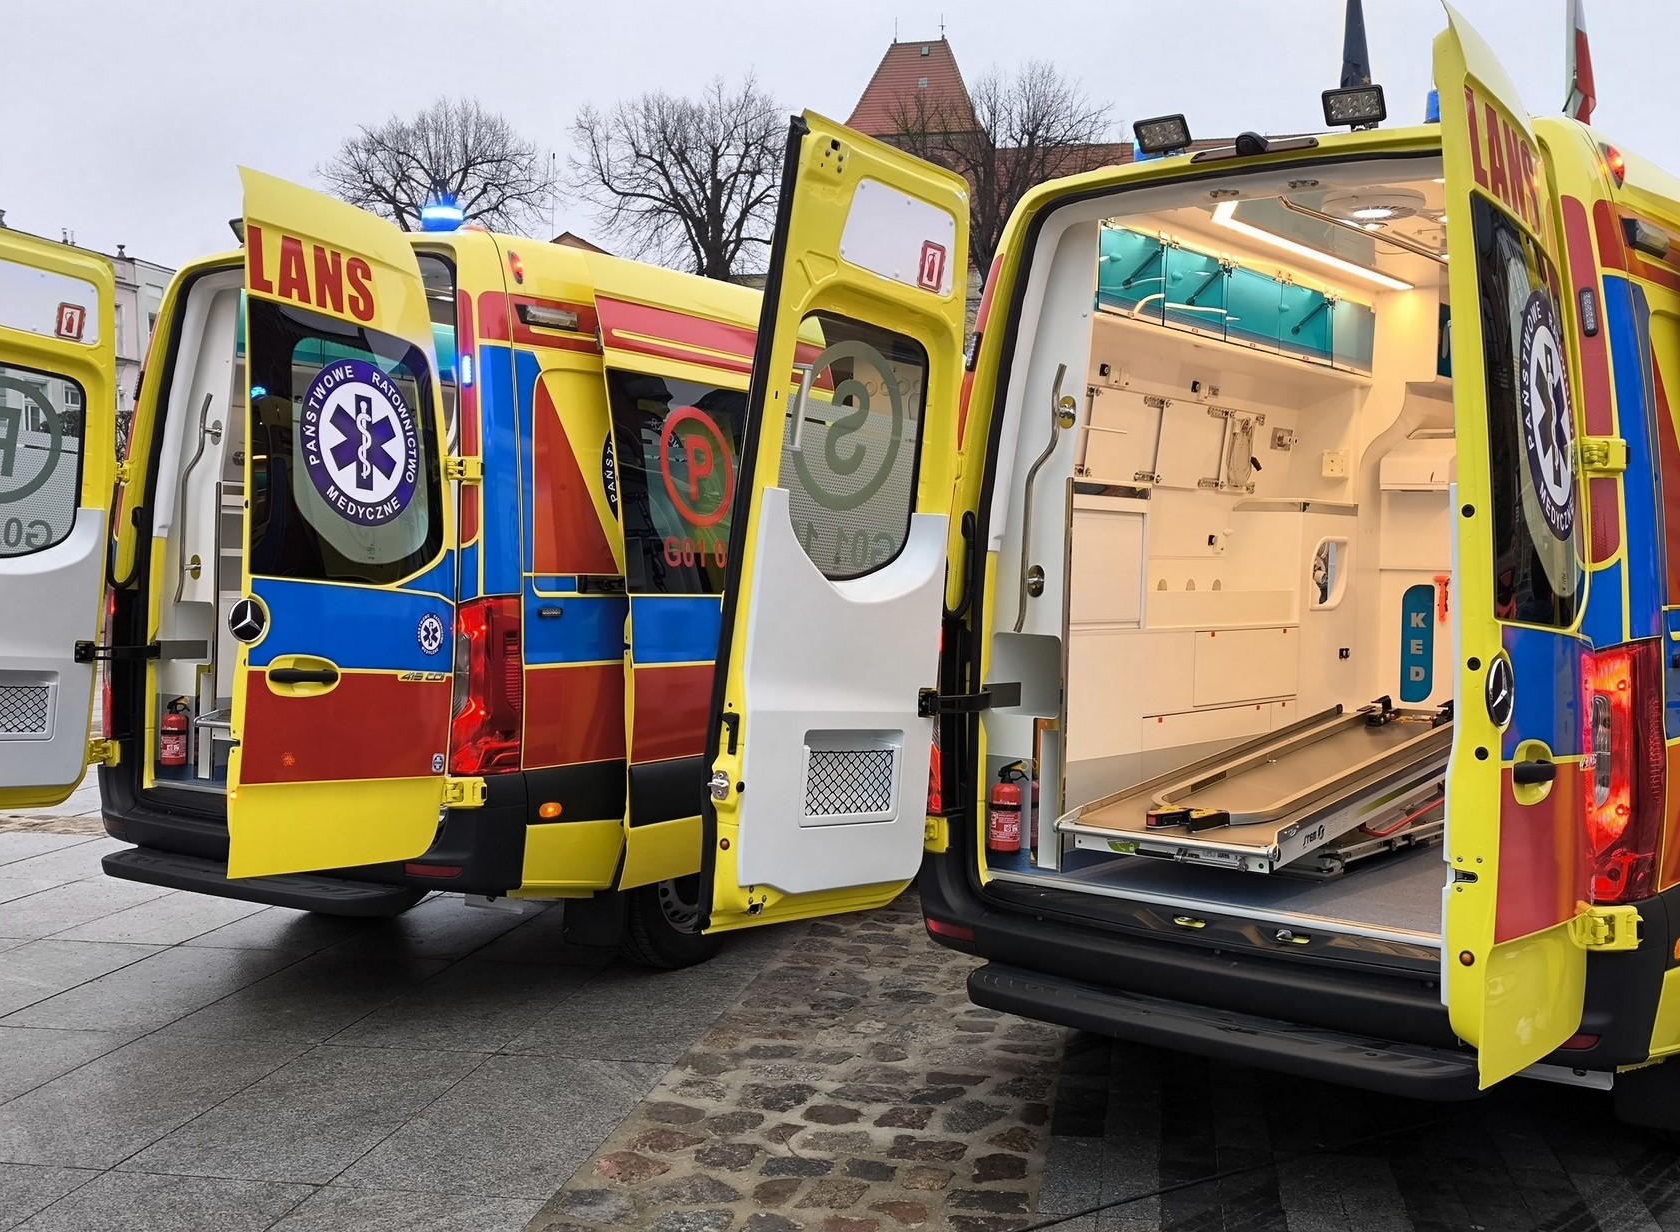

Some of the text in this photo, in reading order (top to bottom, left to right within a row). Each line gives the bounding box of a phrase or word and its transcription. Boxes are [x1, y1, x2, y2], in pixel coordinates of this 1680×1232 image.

[1464, 84, 1540, 236] LANS
[247, 224, 375, 322] LANS
[309, 364, 417, 520] PAŃSTWOWE RATOWNICTWO MEDYCZNE
[663, 535, 706, 568] G01
[1409, 612, 1426, 682] KED
